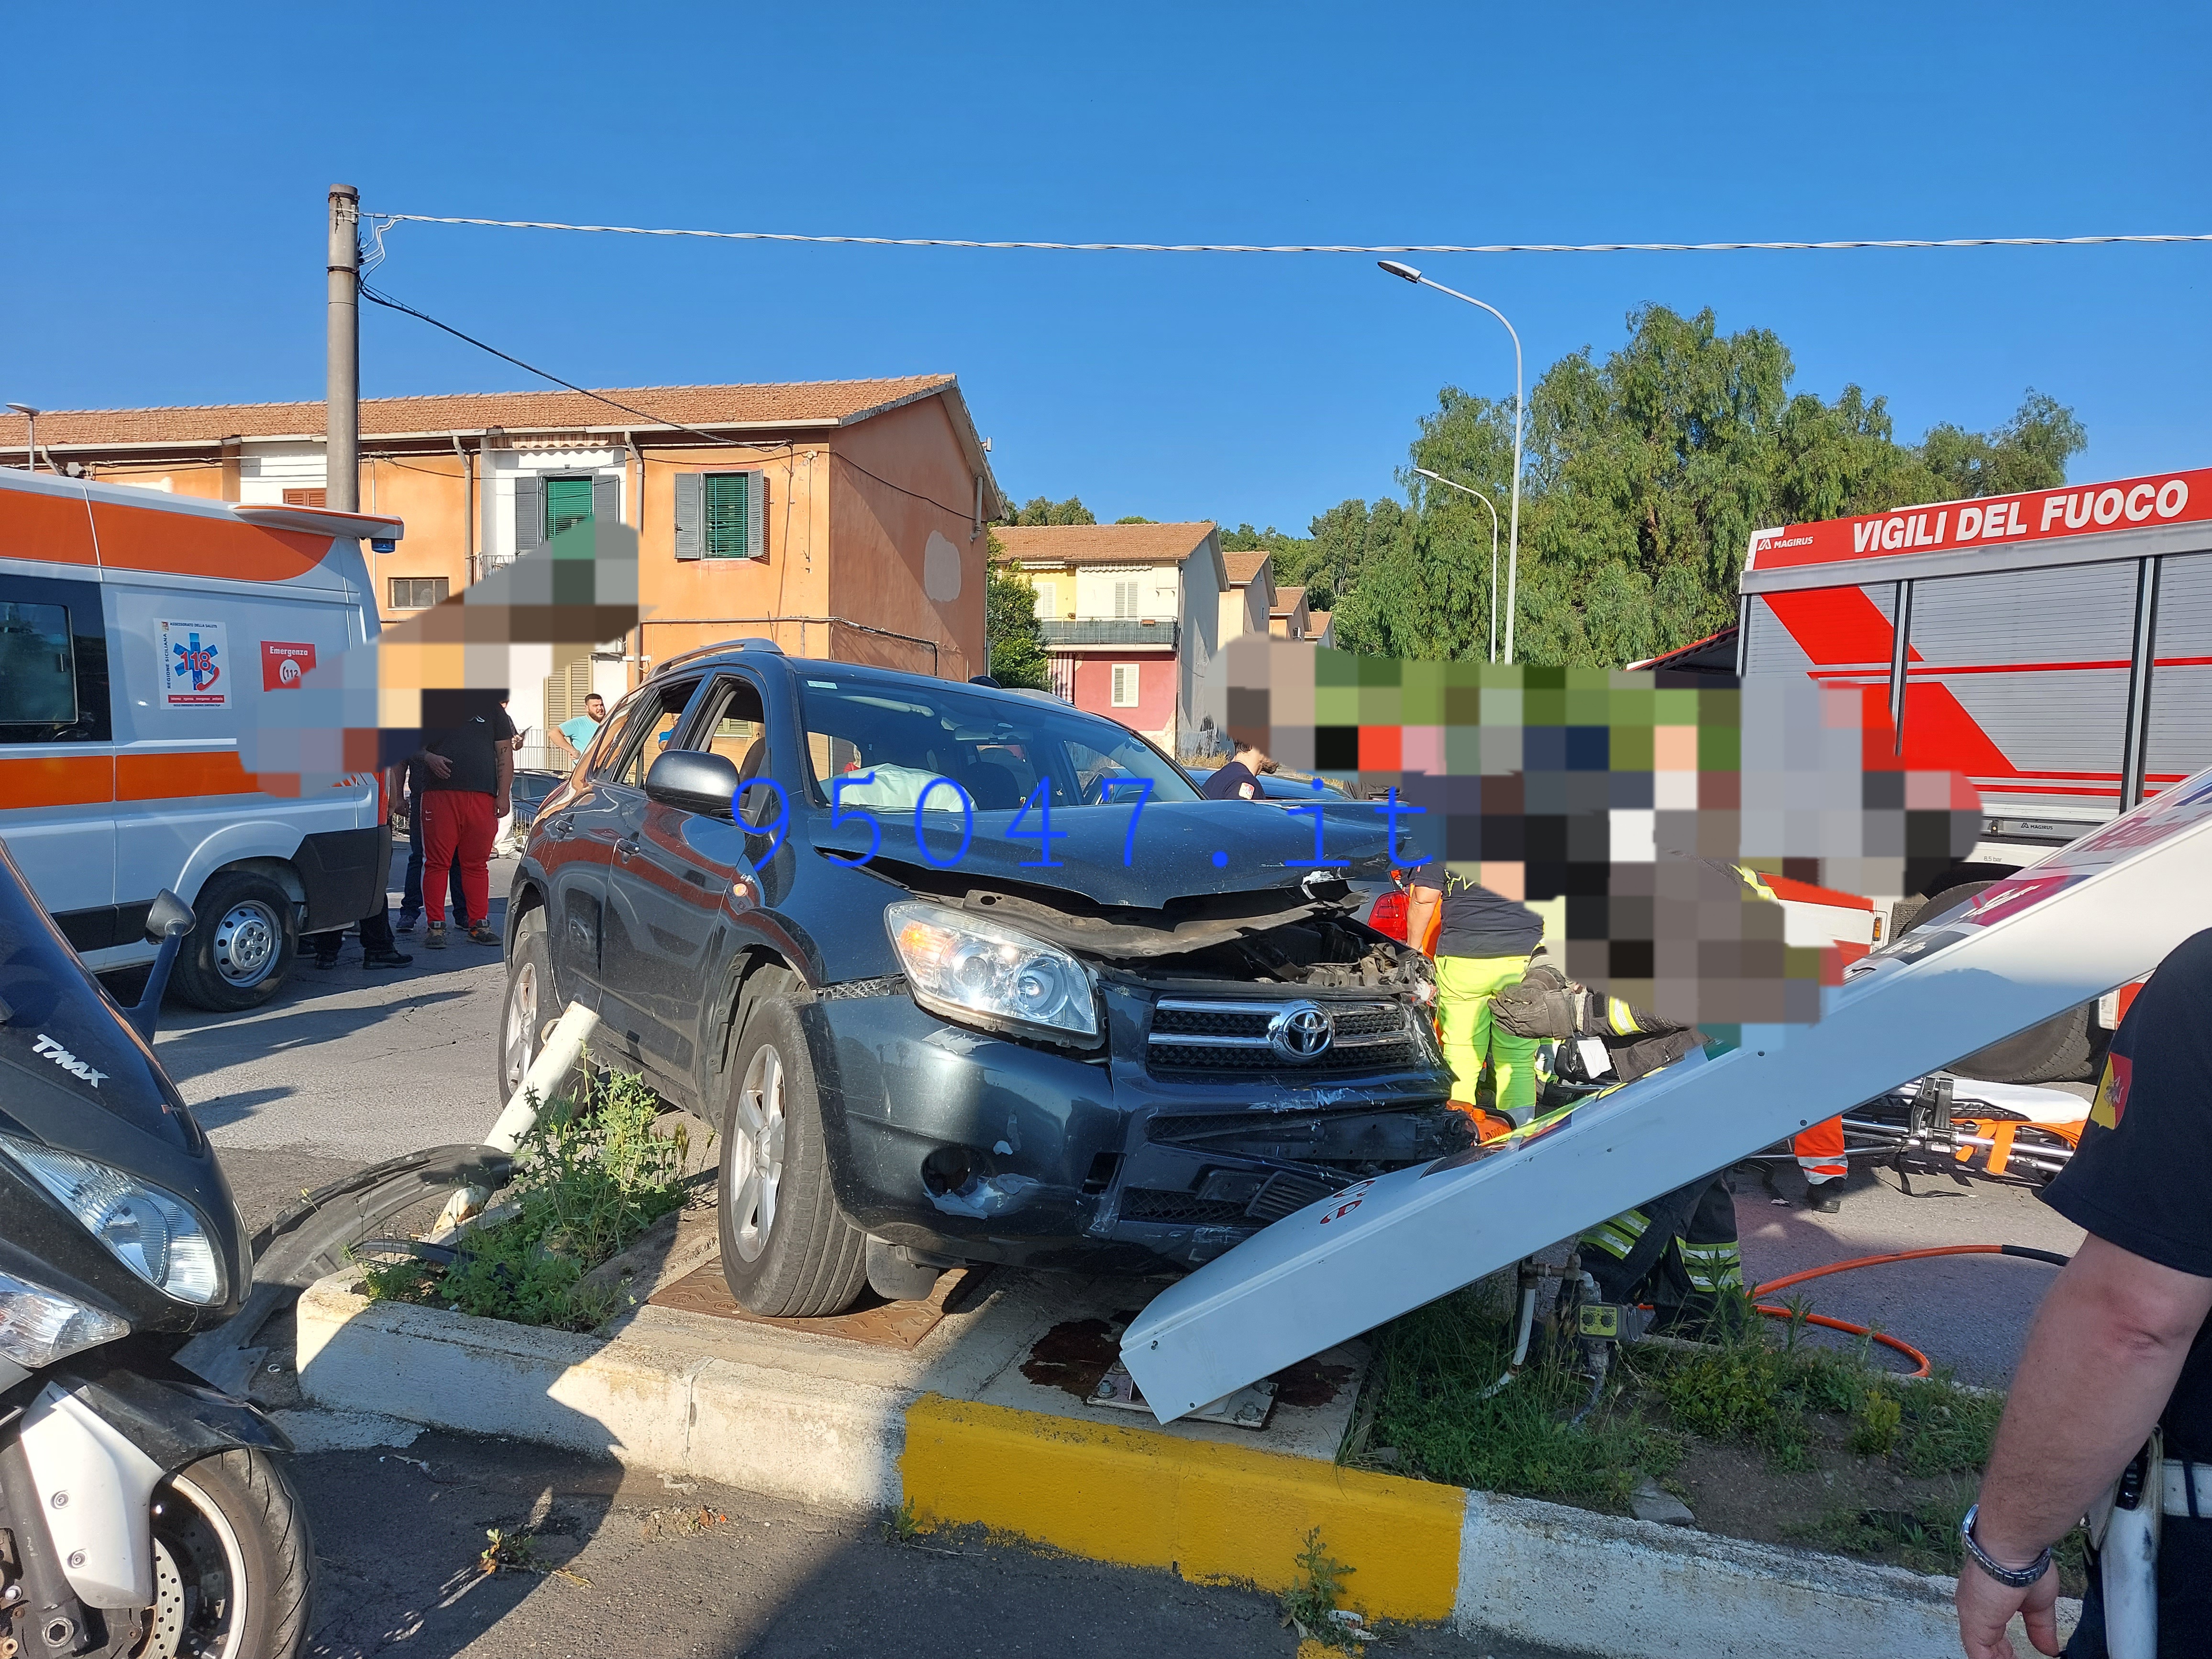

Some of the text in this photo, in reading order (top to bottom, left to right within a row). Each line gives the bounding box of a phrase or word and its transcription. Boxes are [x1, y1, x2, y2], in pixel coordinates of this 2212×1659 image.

[1853, 479, 2189, 553] VIGILI DEL FUOCO
[1773, 536, 1814, 549] MAGIRUS
[269, 646, 308, 657] Emergenza
[180, 651, 212, 671] 118
[286, 669, 299, 677] 112
[32, 1033, 111, 1088] TMAX
